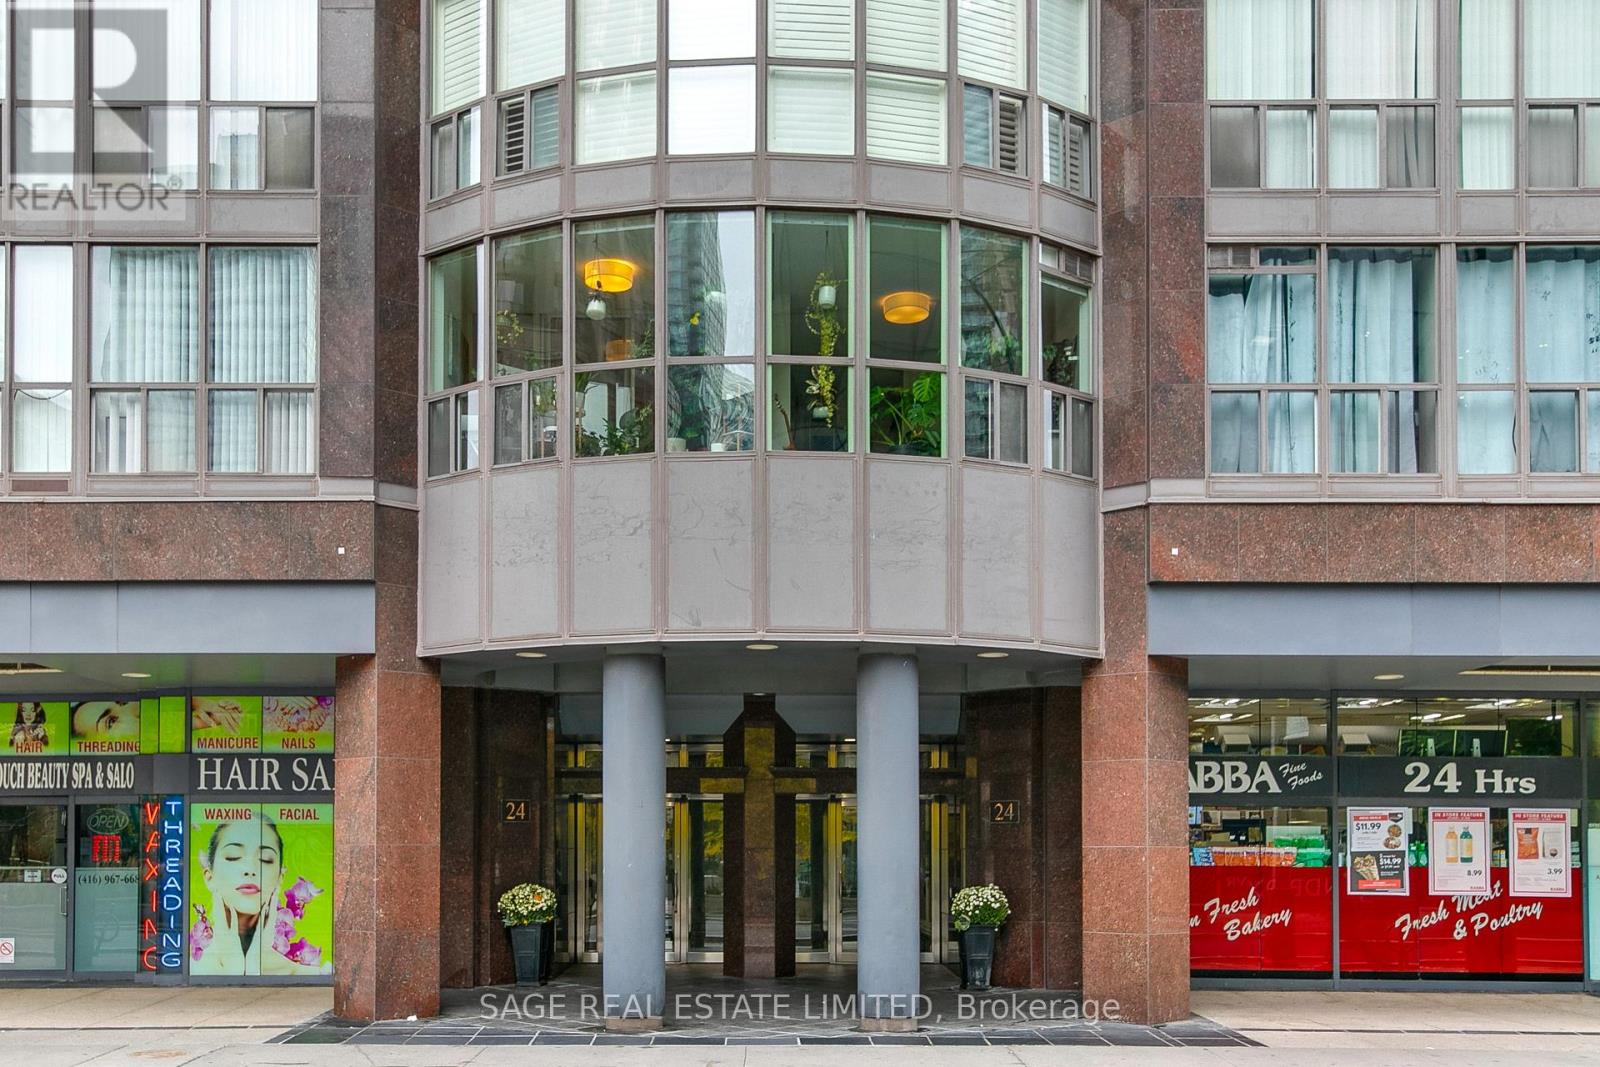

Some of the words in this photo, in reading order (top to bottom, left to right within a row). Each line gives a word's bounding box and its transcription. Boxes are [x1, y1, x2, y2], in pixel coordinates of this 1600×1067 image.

[15, 741, 43, 753] HAIR
[77, 741, 140, 753] THREADING
[197, 737, 259, 749] MANICURE
[281, 737, 316, 749] NAILS
[0, 762, 25, 789] UCH
[27, 762, 70, 789] BEAUTY
[71, 762, 93, 789] SPA
[95, 762, 104, 789] &
[197, 757, 282, 791] HAIR
[291, 757, 335, 792] SA
[1279, 762, 1308, 778] Fine
[1404, 761, 1462, 794] 24
[1475, 769, 1537, 794] Hrs
[1287, 770, 1323, 790] Foods
[204, 808, 252, 820] WAXING
[280, 808, 320, 820] FACIAL
[505, 801, 526, 820] 24
[994, 802, 1015, 821] 24
[89, 814, 126, 828] OPEN
[1355, 822, 1382, 832] $11.99
[1547, 867, 1563, 875] 3.99
[78, 874, 102, 886] (416)
[161, 801, 183, 968] THREADING
[1203, 886, 1259, 924] Fresh
[1223, 908, 1292, 941] Bakery
[1394, 900, 1450, 940] Fresh
[1453, 918, 1468, 940] &
[1470, 901, 1544, 936] Poultry
